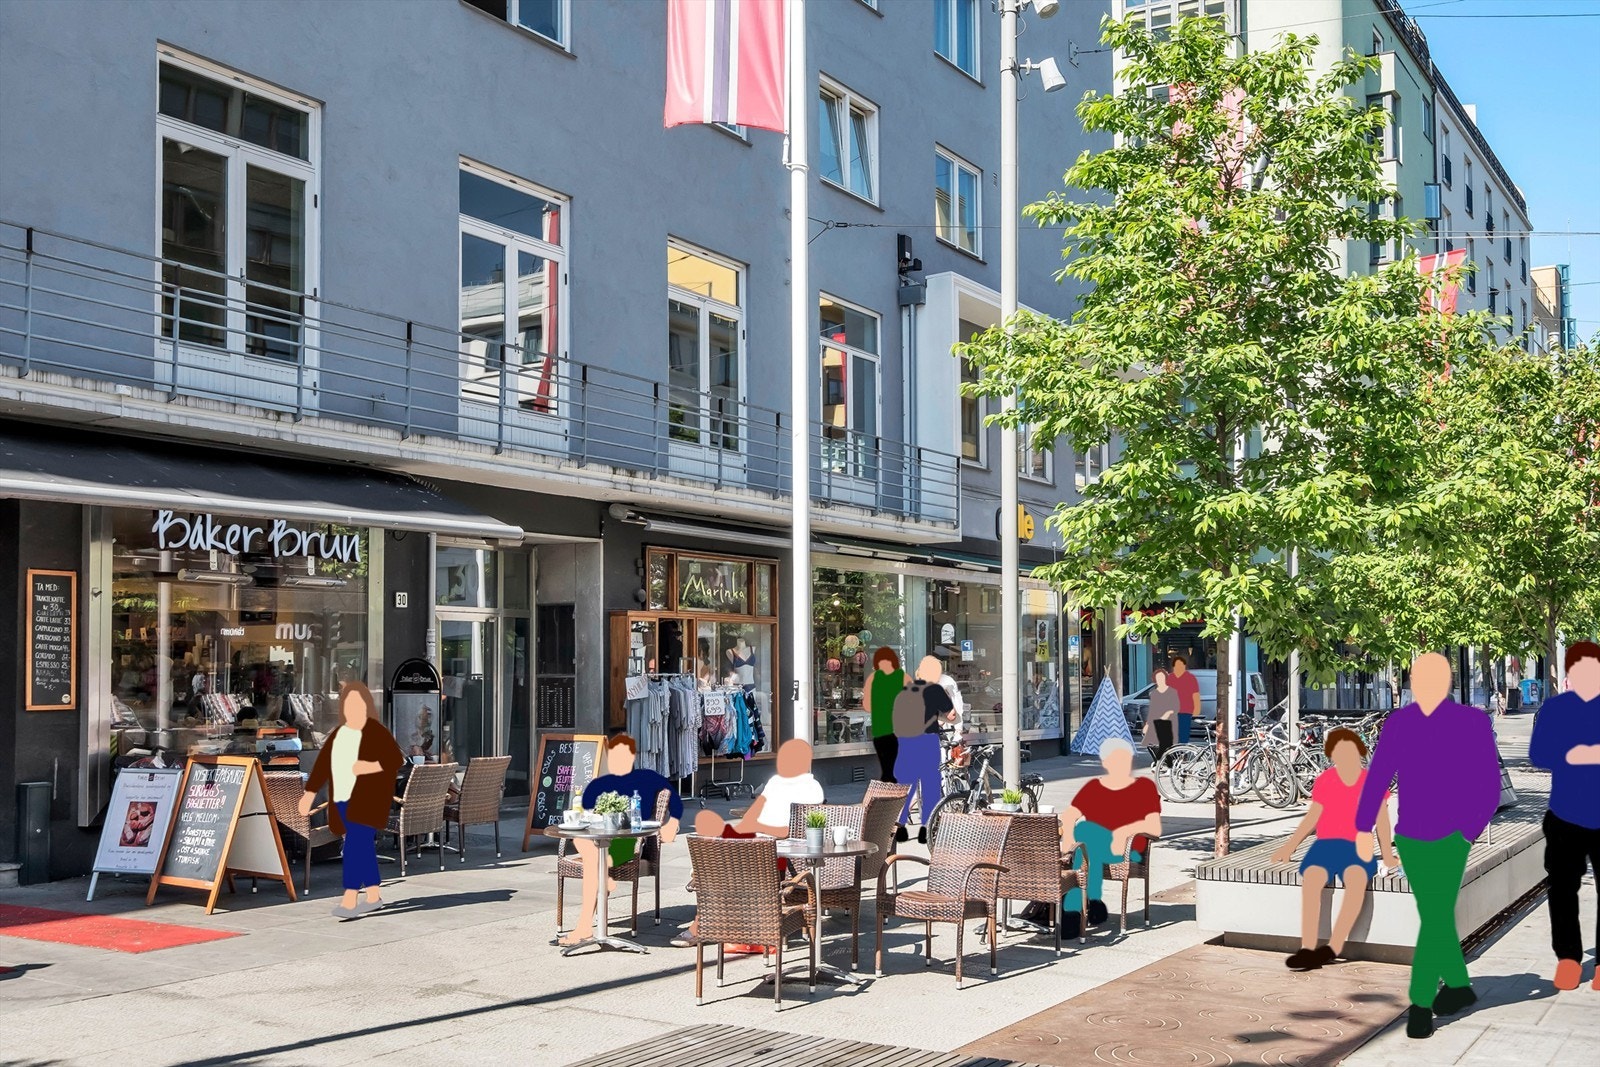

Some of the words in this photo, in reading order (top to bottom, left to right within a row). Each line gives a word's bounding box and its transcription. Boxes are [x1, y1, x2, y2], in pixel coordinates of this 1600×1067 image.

[152, 509, 263, 555] Baker
[268, 519, 361, 563] Brun
[682, 572, 745, 603] Marinka
[398, 594, 406, 606] 30
[548, 815, 565, 825] BEST
